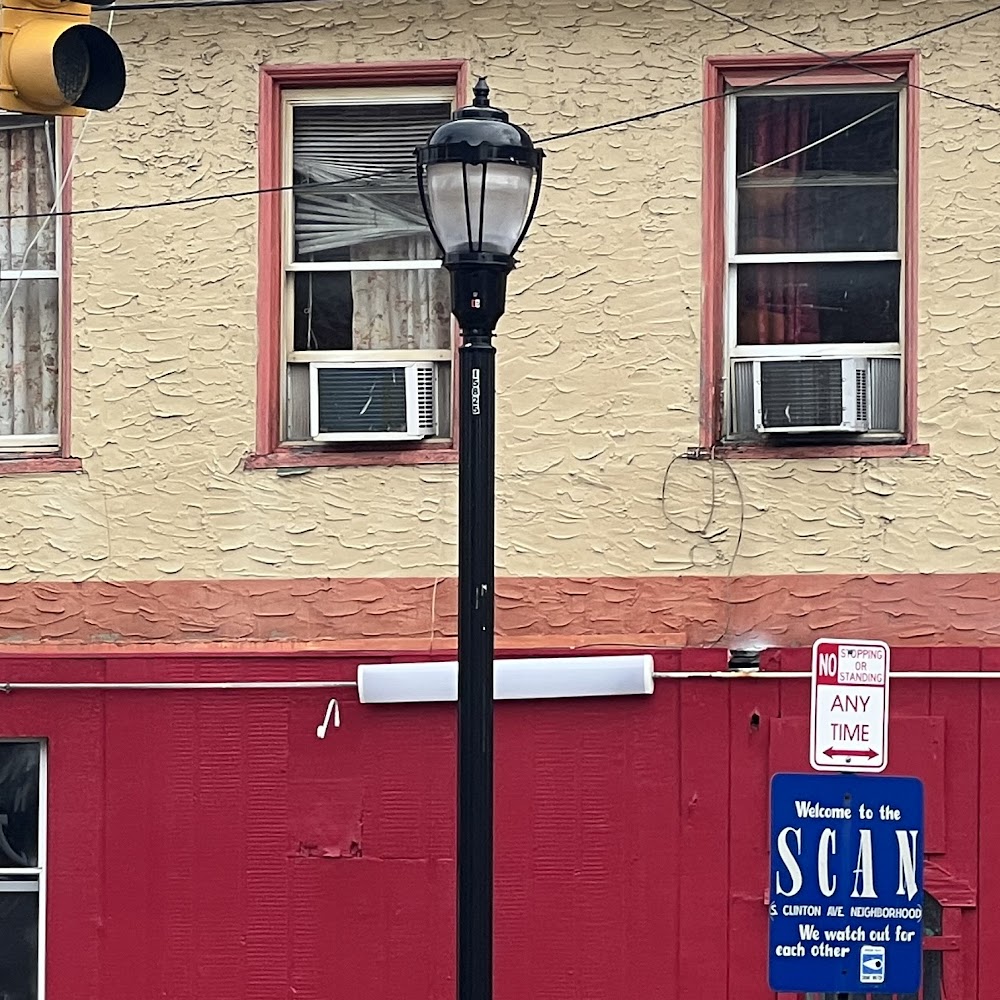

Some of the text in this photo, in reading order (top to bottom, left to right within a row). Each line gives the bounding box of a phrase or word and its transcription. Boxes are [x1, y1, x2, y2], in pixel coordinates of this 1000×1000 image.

[840, 649, 883, 660] STOPPING
[819, 653, 837, 677] NO
[855, 661, 867, 671] OR
[839, 672, 882, 683] STANDING
[830, 695, 870, 712] ANY
[830, 723, 869, 742] TIME
[795, 801, 901, 820] Welcome to the
[776, 827, 918, 901] SCAN
[782, 906, 821, 916] CLINTON
[799, 924, 915, 942] We watch out for
[775, 942, 850, 958] each other
